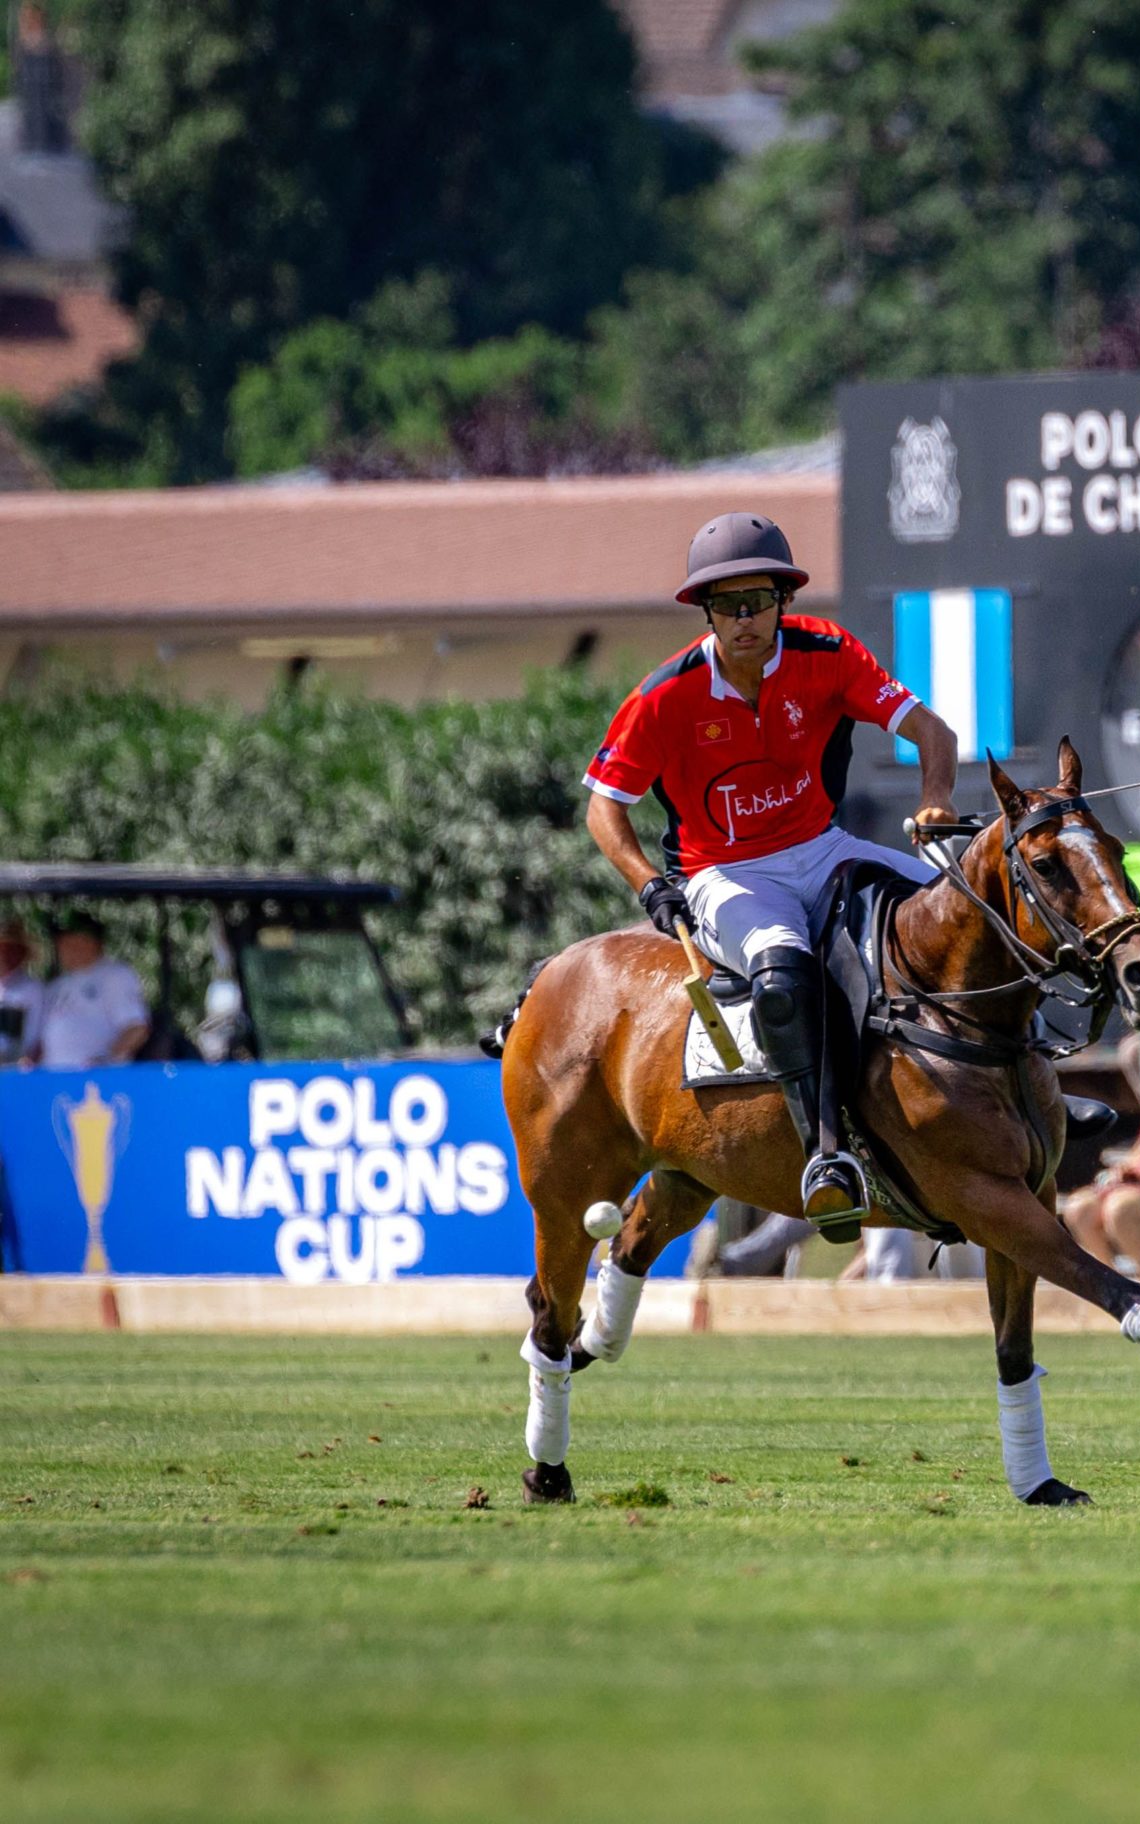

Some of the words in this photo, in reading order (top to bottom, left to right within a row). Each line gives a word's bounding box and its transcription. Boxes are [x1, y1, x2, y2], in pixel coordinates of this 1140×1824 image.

[1006, 477, 1074, 538] DE
[249, 1076, 451, 1147] POLO
[186, 1142, 508, 1218] NATIONS
[275, 1214, 424, 1283] CUP
